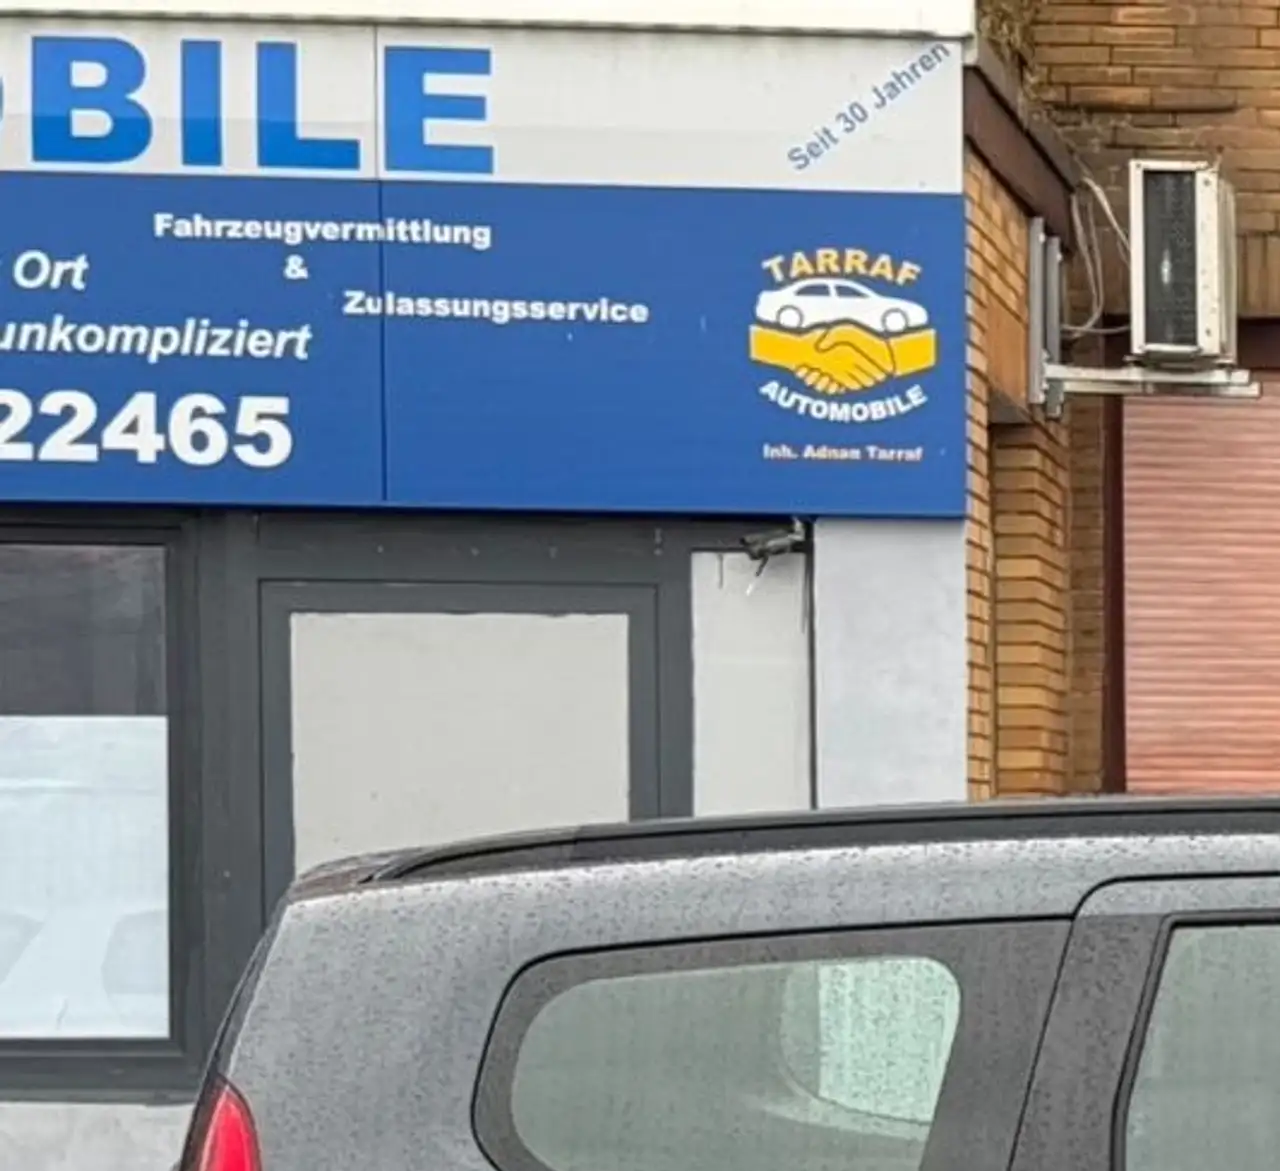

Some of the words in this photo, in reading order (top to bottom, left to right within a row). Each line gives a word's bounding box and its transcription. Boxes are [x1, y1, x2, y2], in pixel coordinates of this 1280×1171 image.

[0, 36, 493, 173] BILE
[787, 127, 840, 170] Seit
[835, 101, 869, 133] 30
[871, 43, 950, 110] Jahren
[154, 213, 492, 249] Fahrzeugvermittlung
[13, 250, 88, 290] Ort
[283, 254, 309, 280] &
[761, 248, 921, 285] TARRAF
[343, 290, 649, 325] Zulassungsservice
[759, 380, 928, 423] AUTOMOBILE
[763, 443, 799, 460] Inh.
[865, 445, 924, 462] Tarraf
